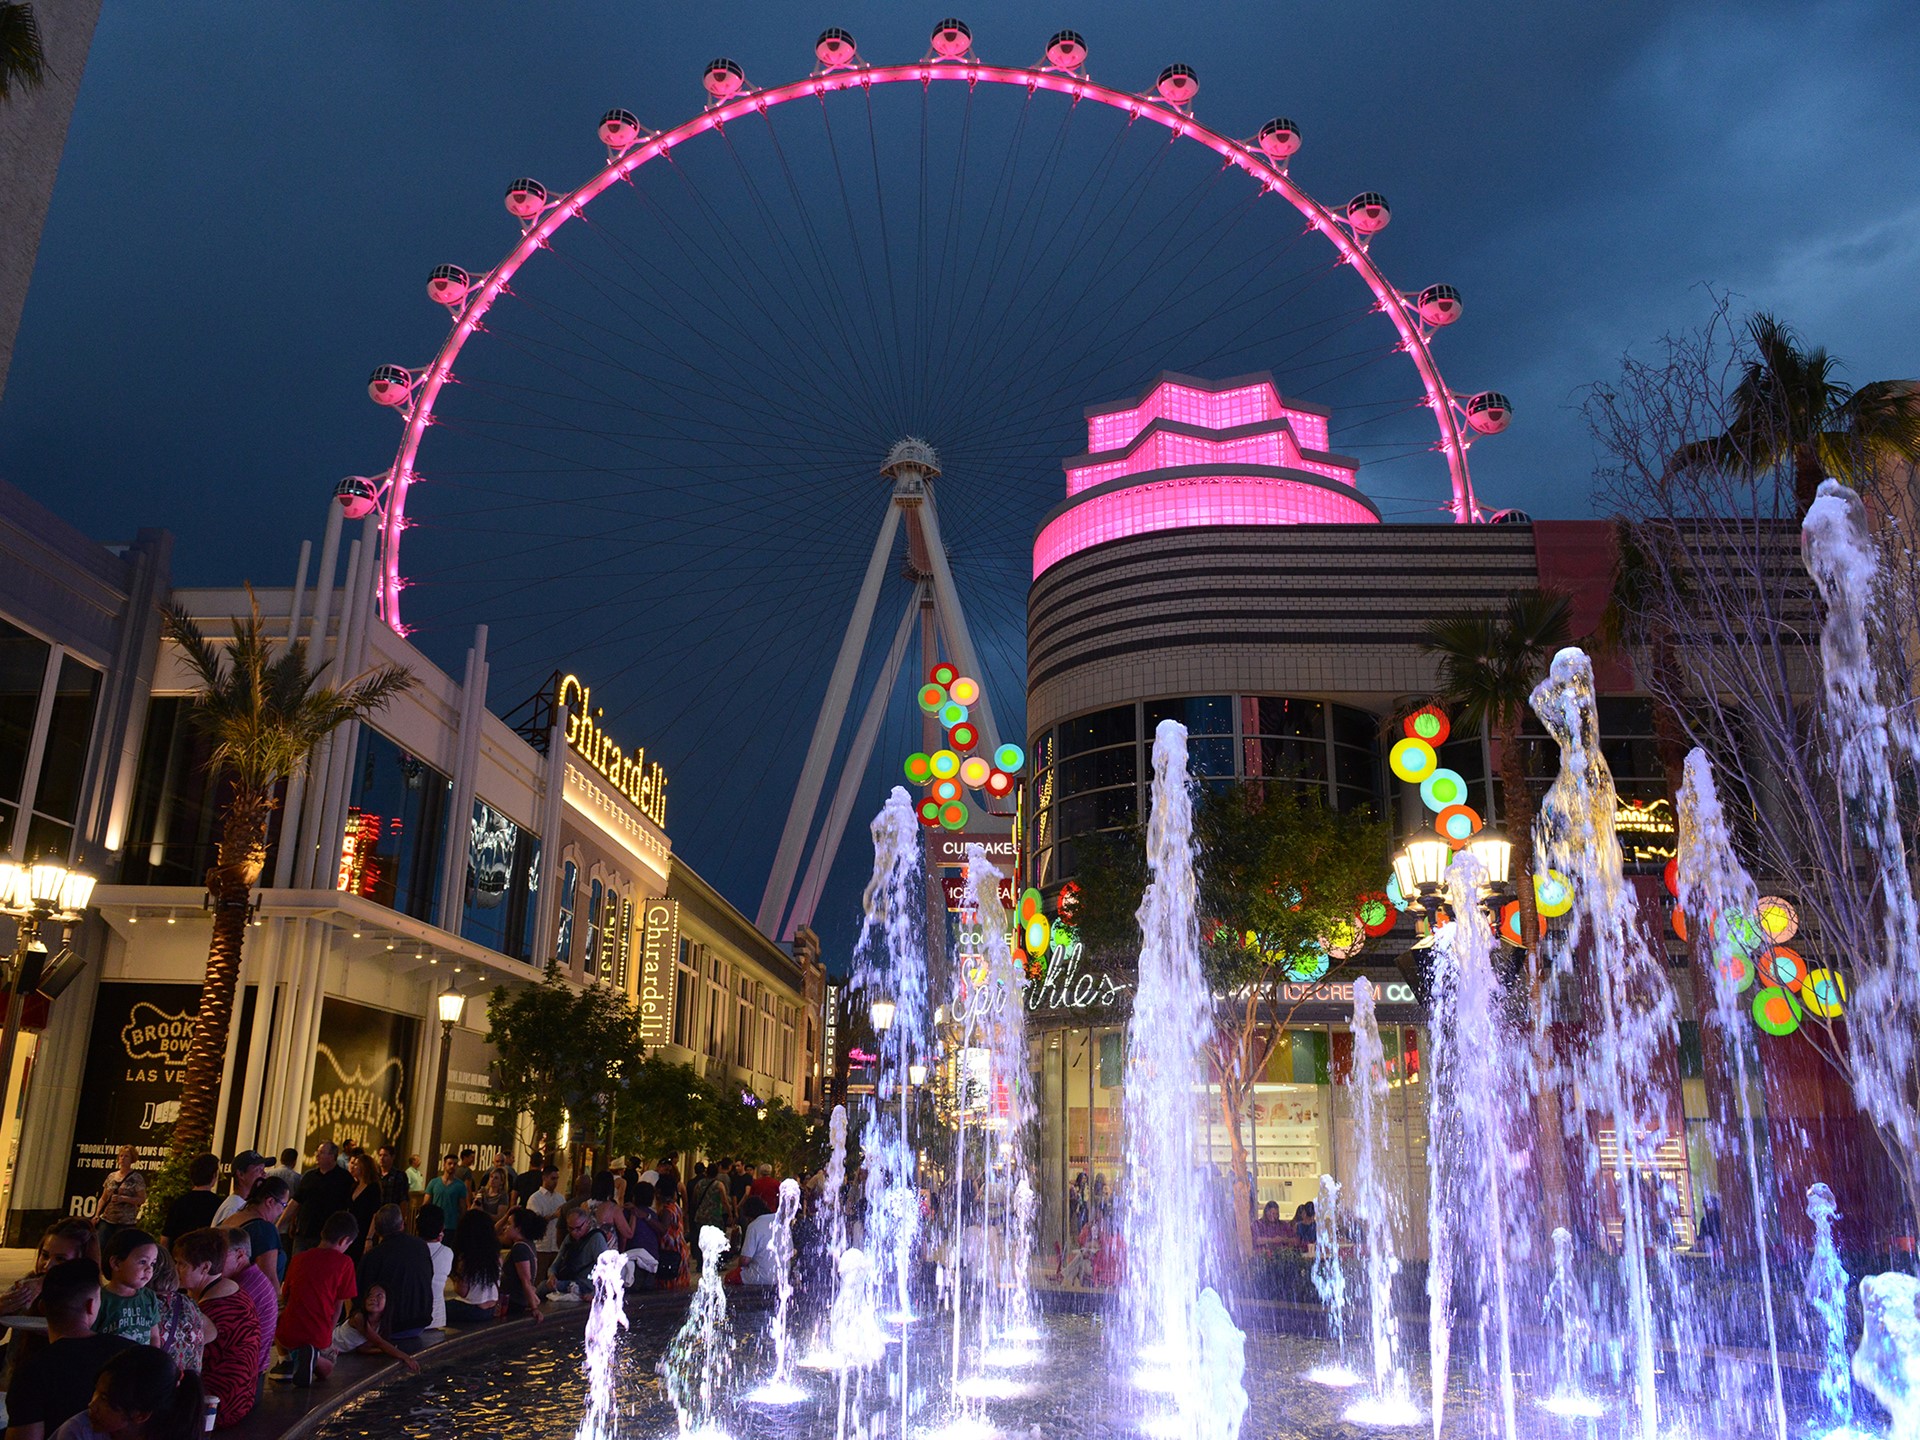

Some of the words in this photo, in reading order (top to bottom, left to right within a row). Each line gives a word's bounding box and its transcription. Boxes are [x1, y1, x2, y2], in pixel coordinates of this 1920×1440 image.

[558, 673, 669, 830] Ghirardelli
[639, 905, 670, 1038] Ghirardelli
[828, 986, 838, 1025] Yard
[1283, 983, 1313, 1001] ICE
[1315, 983, 1382, 1001] CREM
[131, 1021, 196, 1046] BROOK
[160, 1039, 193, 1052] BOW
[826, 1026, 836, 1075] House
[126, 1069, 158, 1082] LAS
[306, 1087, 397, 1139] BROOKLYN
[333, 1122, 370, 1149] BOWL
[91, 1158, 104, 1169] ONE
[105, 1159, 114, 1170] OF
